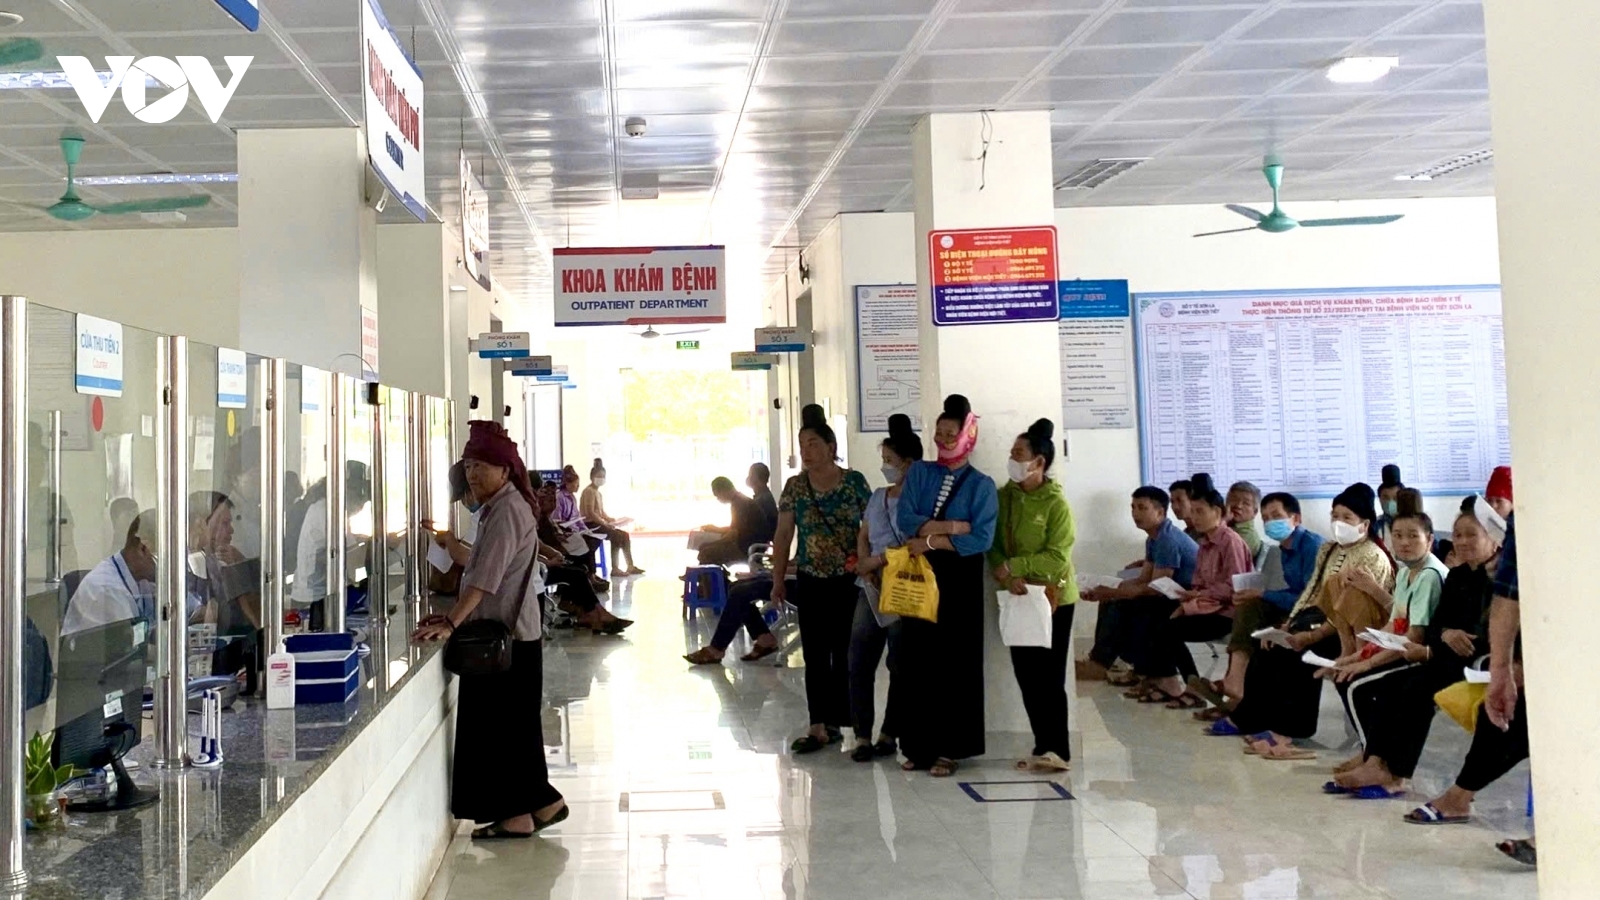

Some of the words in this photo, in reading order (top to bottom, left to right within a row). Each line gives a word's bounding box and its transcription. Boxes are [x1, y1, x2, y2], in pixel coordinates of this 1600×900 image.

[562, 269, 606, 293] KHOA
[614, 263, 663, 292] KHÁM
[672, 262, 716, 295] BỆNH
[571, 300, 635, 310] OUTPATIENT
[640, 299, 709, 309] DEPARTMENT
